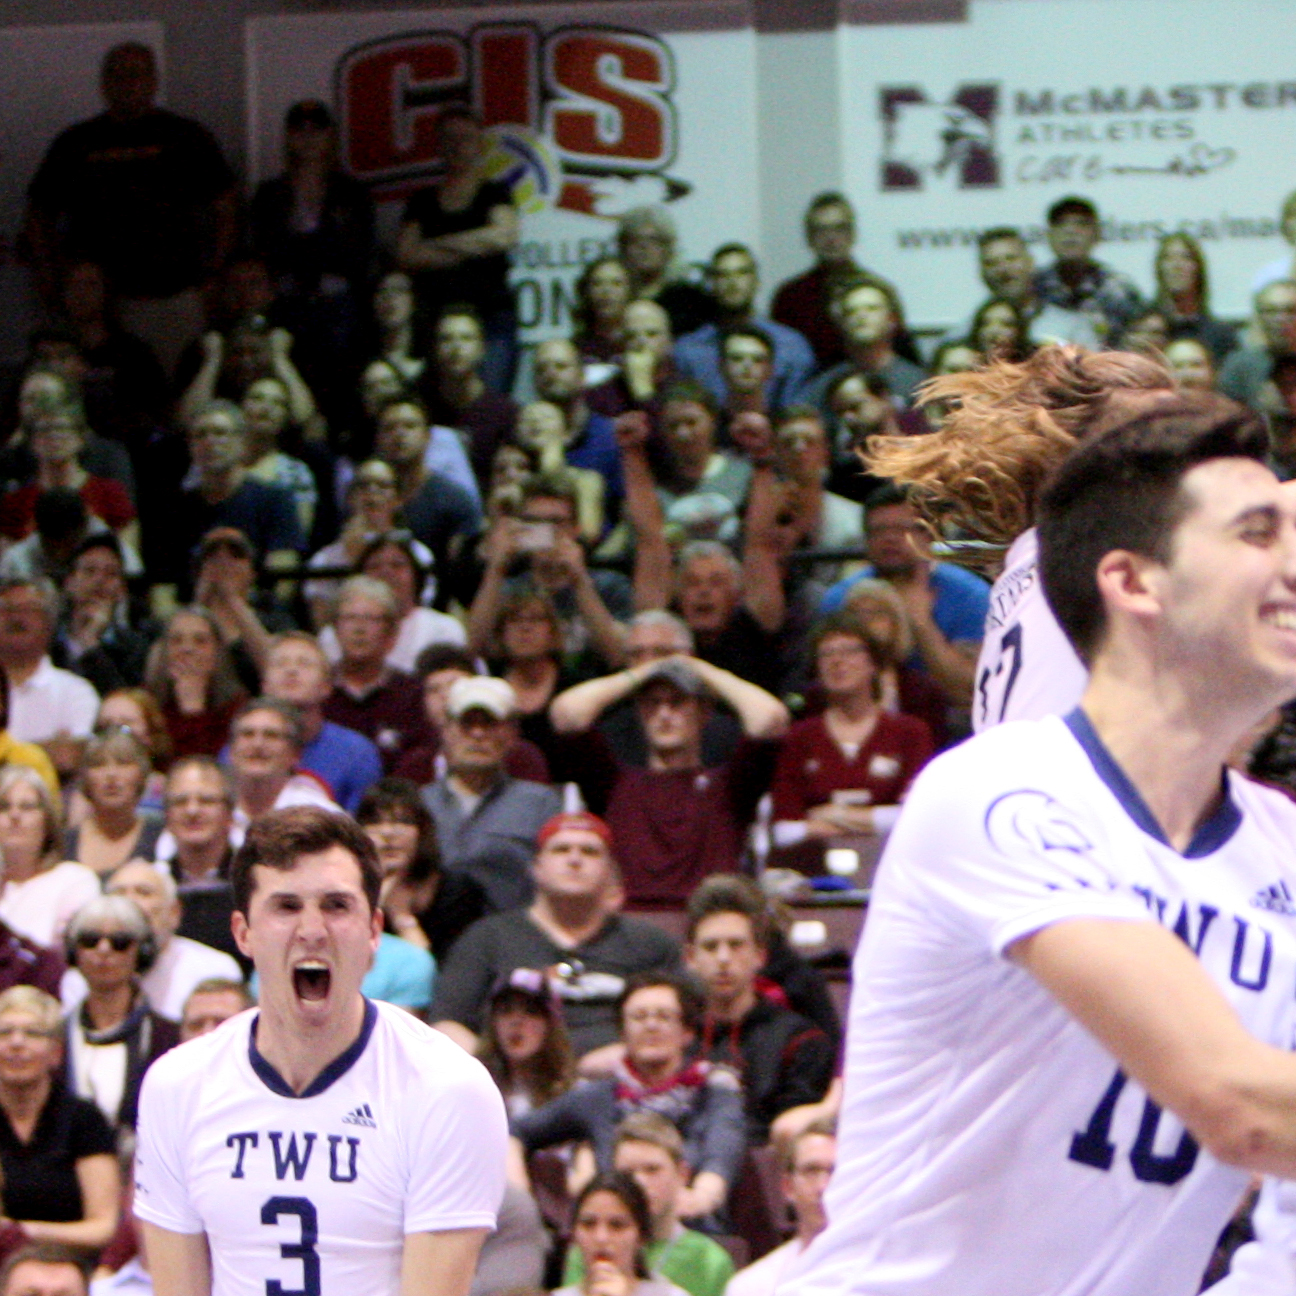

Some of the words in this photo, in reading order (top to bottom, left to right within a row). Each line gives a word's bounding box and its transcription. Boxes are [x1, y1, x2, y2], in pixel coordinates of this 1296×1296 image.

[334, 21, 677, 183] CIS
[1017, 118, 1195, 143] ATHLETES
[226, 1131, 361, 1183] TWU
